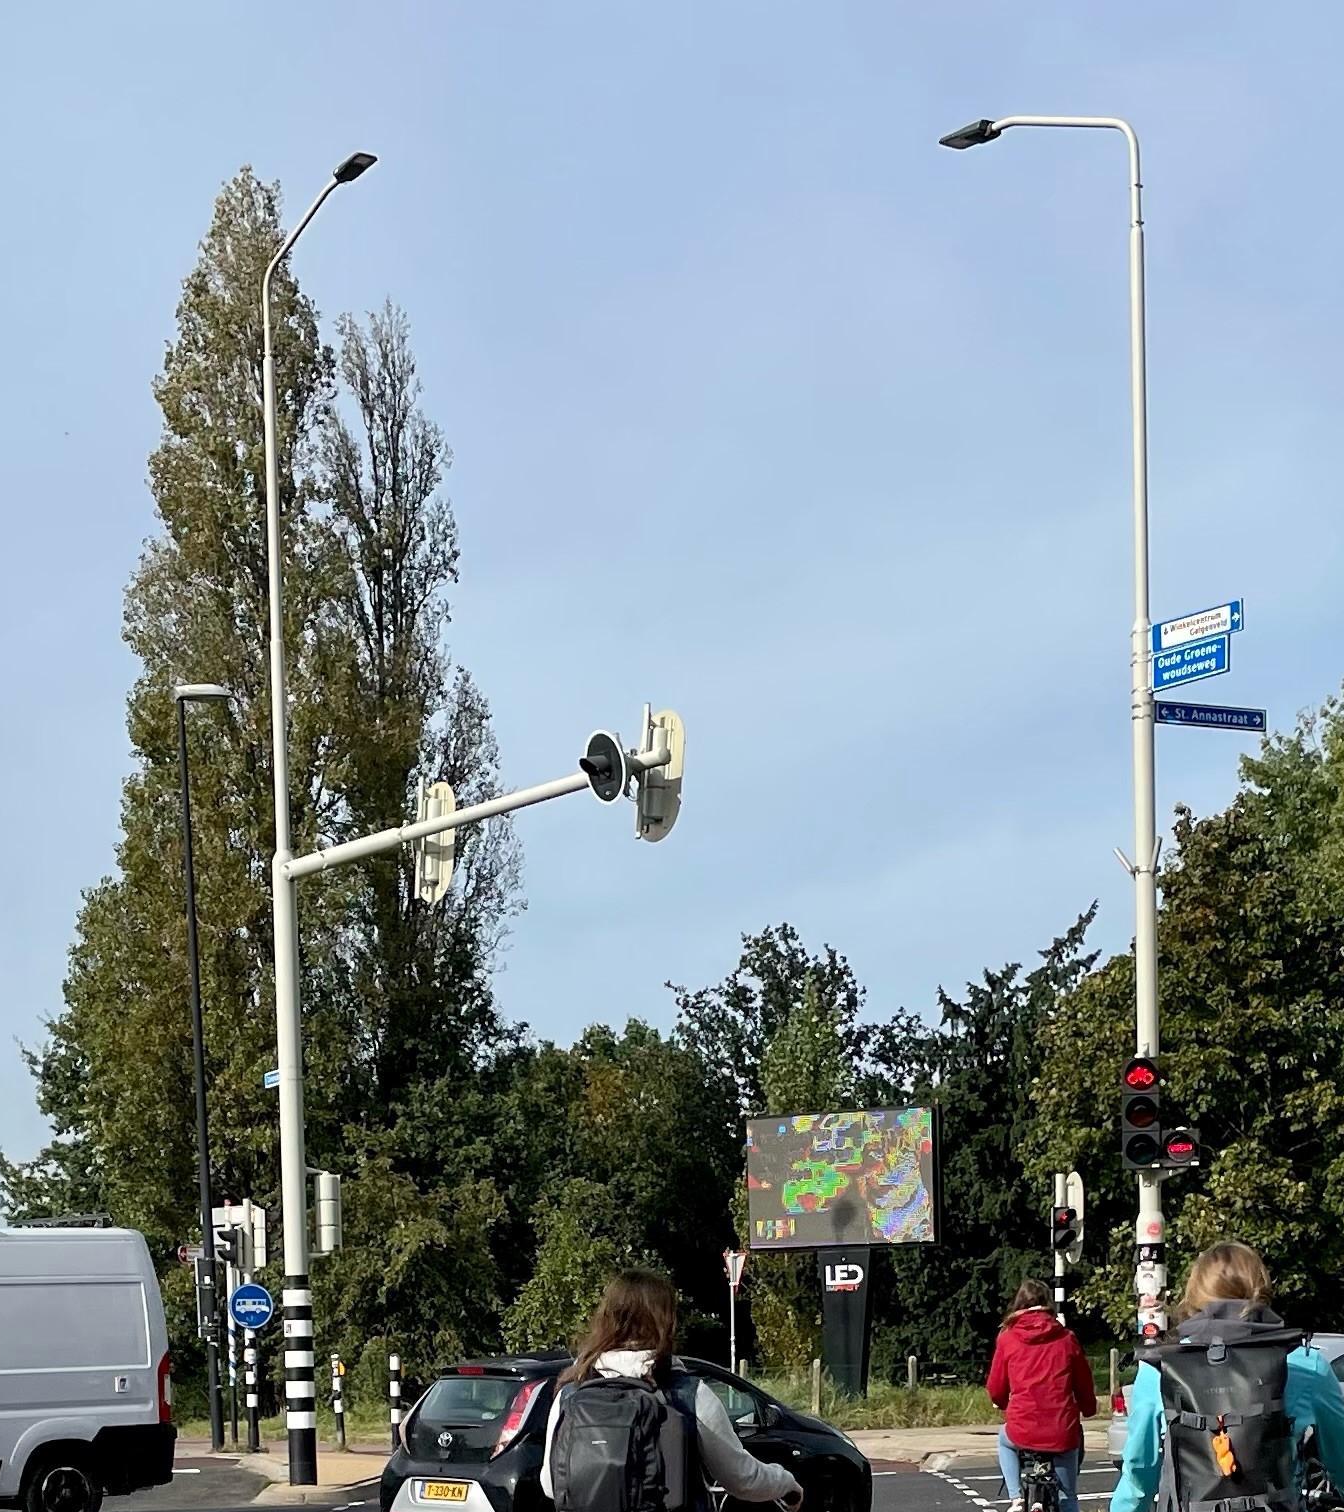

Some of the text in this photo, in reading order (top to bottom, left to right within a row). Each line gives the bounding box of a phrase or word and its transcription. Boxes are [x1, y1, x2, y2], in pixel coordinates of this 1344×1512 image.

[1158, 644, 1221, 669] Oude Groene-
[1162, 657, 1217, 681] woudseweg
[1175, 708, 1248, 724] St. Annastraat
[825, 1264, 864, 1285] LED
